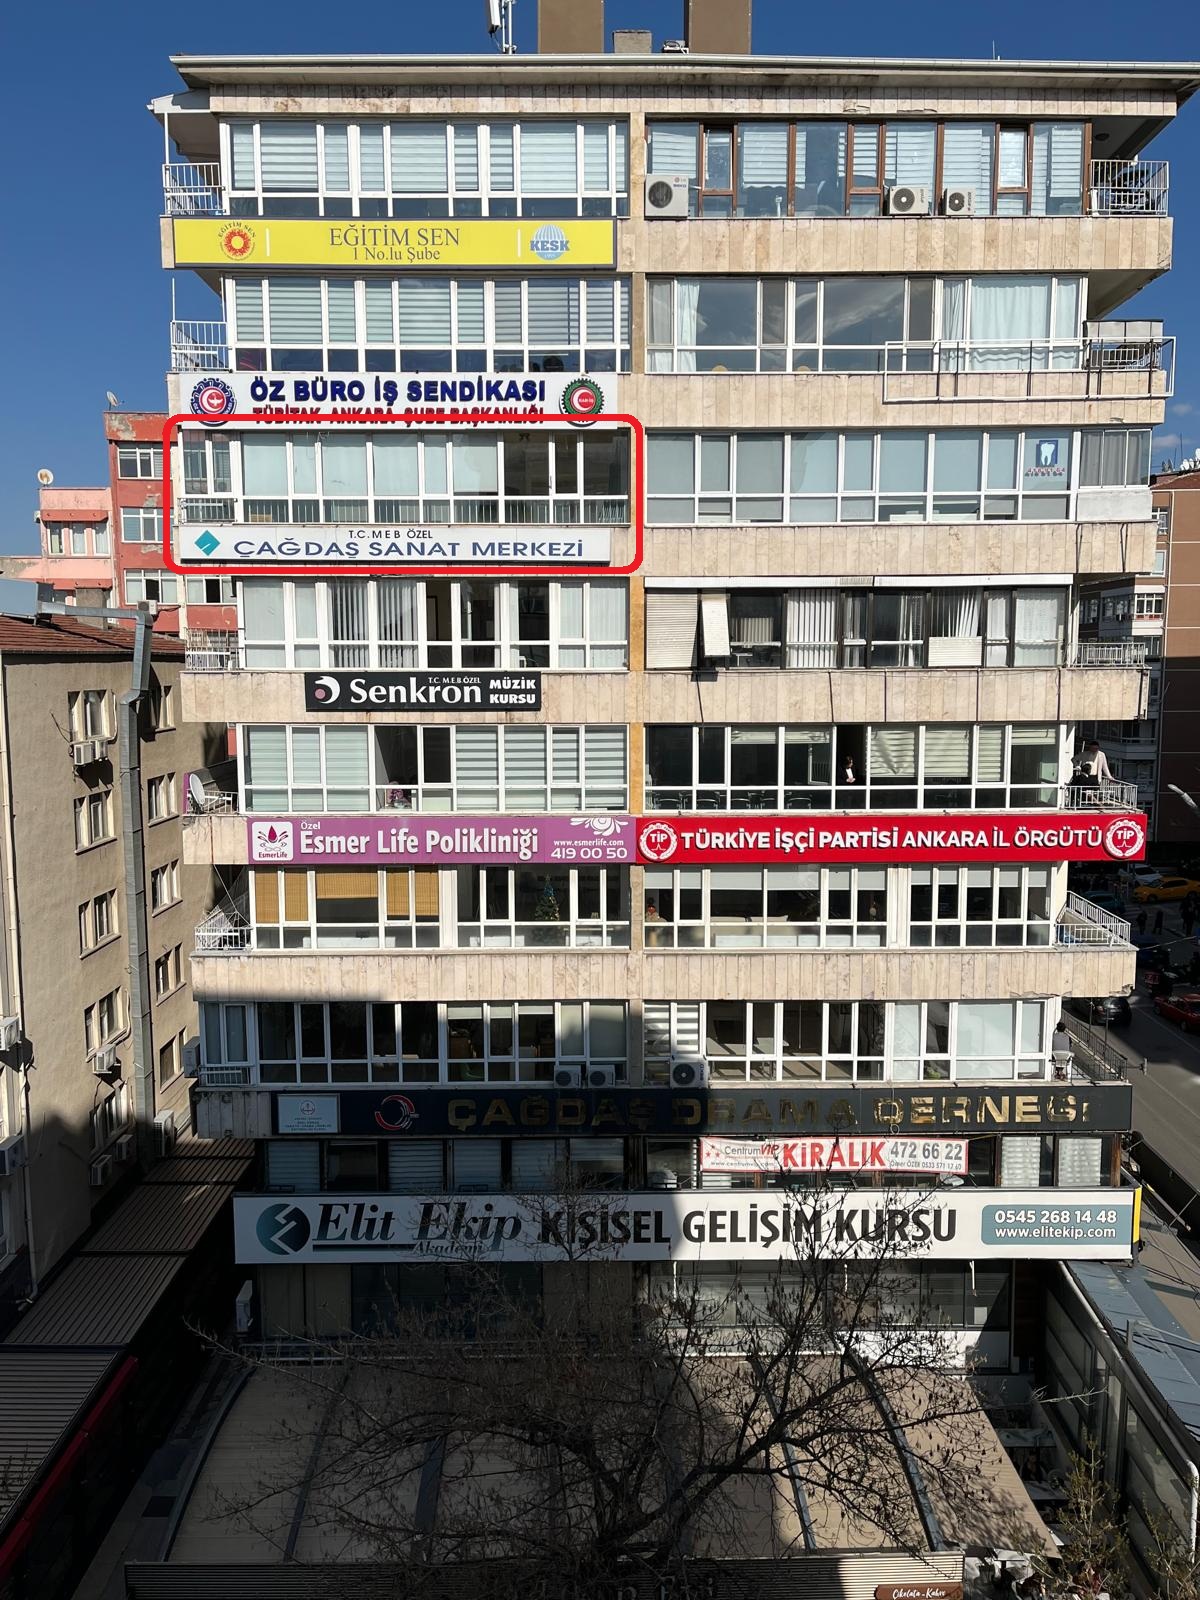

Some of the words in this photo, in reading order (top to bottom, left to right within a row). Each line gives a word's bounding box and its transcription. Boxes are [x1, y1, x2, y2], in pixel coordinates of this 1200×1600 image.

[330, 224, 410, 246] EĞİTİM
[417, 228, 460, 246] SEN
[530, 240, 570, 251] KESK
[353, 248, 359, 260] 1
[365, 247, 402, 261] No.lu
[407, 247, 441, 263] Şube
[250, 376, 285, 401] ÖZ
[294, 376, 365, 402] BÜRO
[375, 376, 398, 406] İŞ
[407, 375, 545, 402] SENDİKASI
[330, 407, 393, 424] ANKARA
[406, 528, 433, 539] ÖZEL
[234, 538, 360, 558] ÇAĞDAŞ
[368, 541, 460, 556] SANAT
[472, 539, 583, 557] MERKEZİ
[350, 677, 482, 704] Senkron
[489, 677, 536, 690] MÜZİK
[489, 693, 536, 704] KURSU
[300, 820, 321, 831] Özel
[650, 831, 668, 843] TİP
[681, 828, 770, 849] TÜRKİYE
[775, 827, 815, 852] İŞÇİ
[819, 827, 898, 848] PARTİSİ
[902, 830, 989, 848] ANKARA
[992, 827, 1010, 847] İL
[1014, 826, 1103, 847] ÖRGÜTÜ
[1116, 828, 1134, 840] TİP
[301, 830, 370, 854] Esmer
[378, 828, 418, 854] Life
[426, 828, 538, 860] Polikliniği
[554, 838, 624, 847] www.esmerlife.com
[258, 851, 288, 859] EsmerLife
[551, 847, 576, 859] 419
[580, 847, 602, 859] 00
[606, 847, 628, 859] 50
[672, 1098, 858, 1126] DRAMA
[783, 1141, 886, 1168] KİRALIK
[890, 1142, 918, 1159] 472
[922, 1143, 940, 1160] 66
[945, 1143, 963, 1161] 22
[922, 1161, 936, 1169] 0533
[994, 1210, 1036, 1224] 0545
[1040, 1210, 1070, 1224] 268
[1075, 1210, 1092, 1224] 14
[1096, 1210, 1117, 1224] 48
[312, 1203, 396, 1241] Elit
[413, 1203, 523, 1252] Ekip
[682, 1203, 822, 1248] GELİŞİM
[836, 1208, 956, 1242] KURSU
[994, 1226, 1116, 1240] www.elitekip.com
